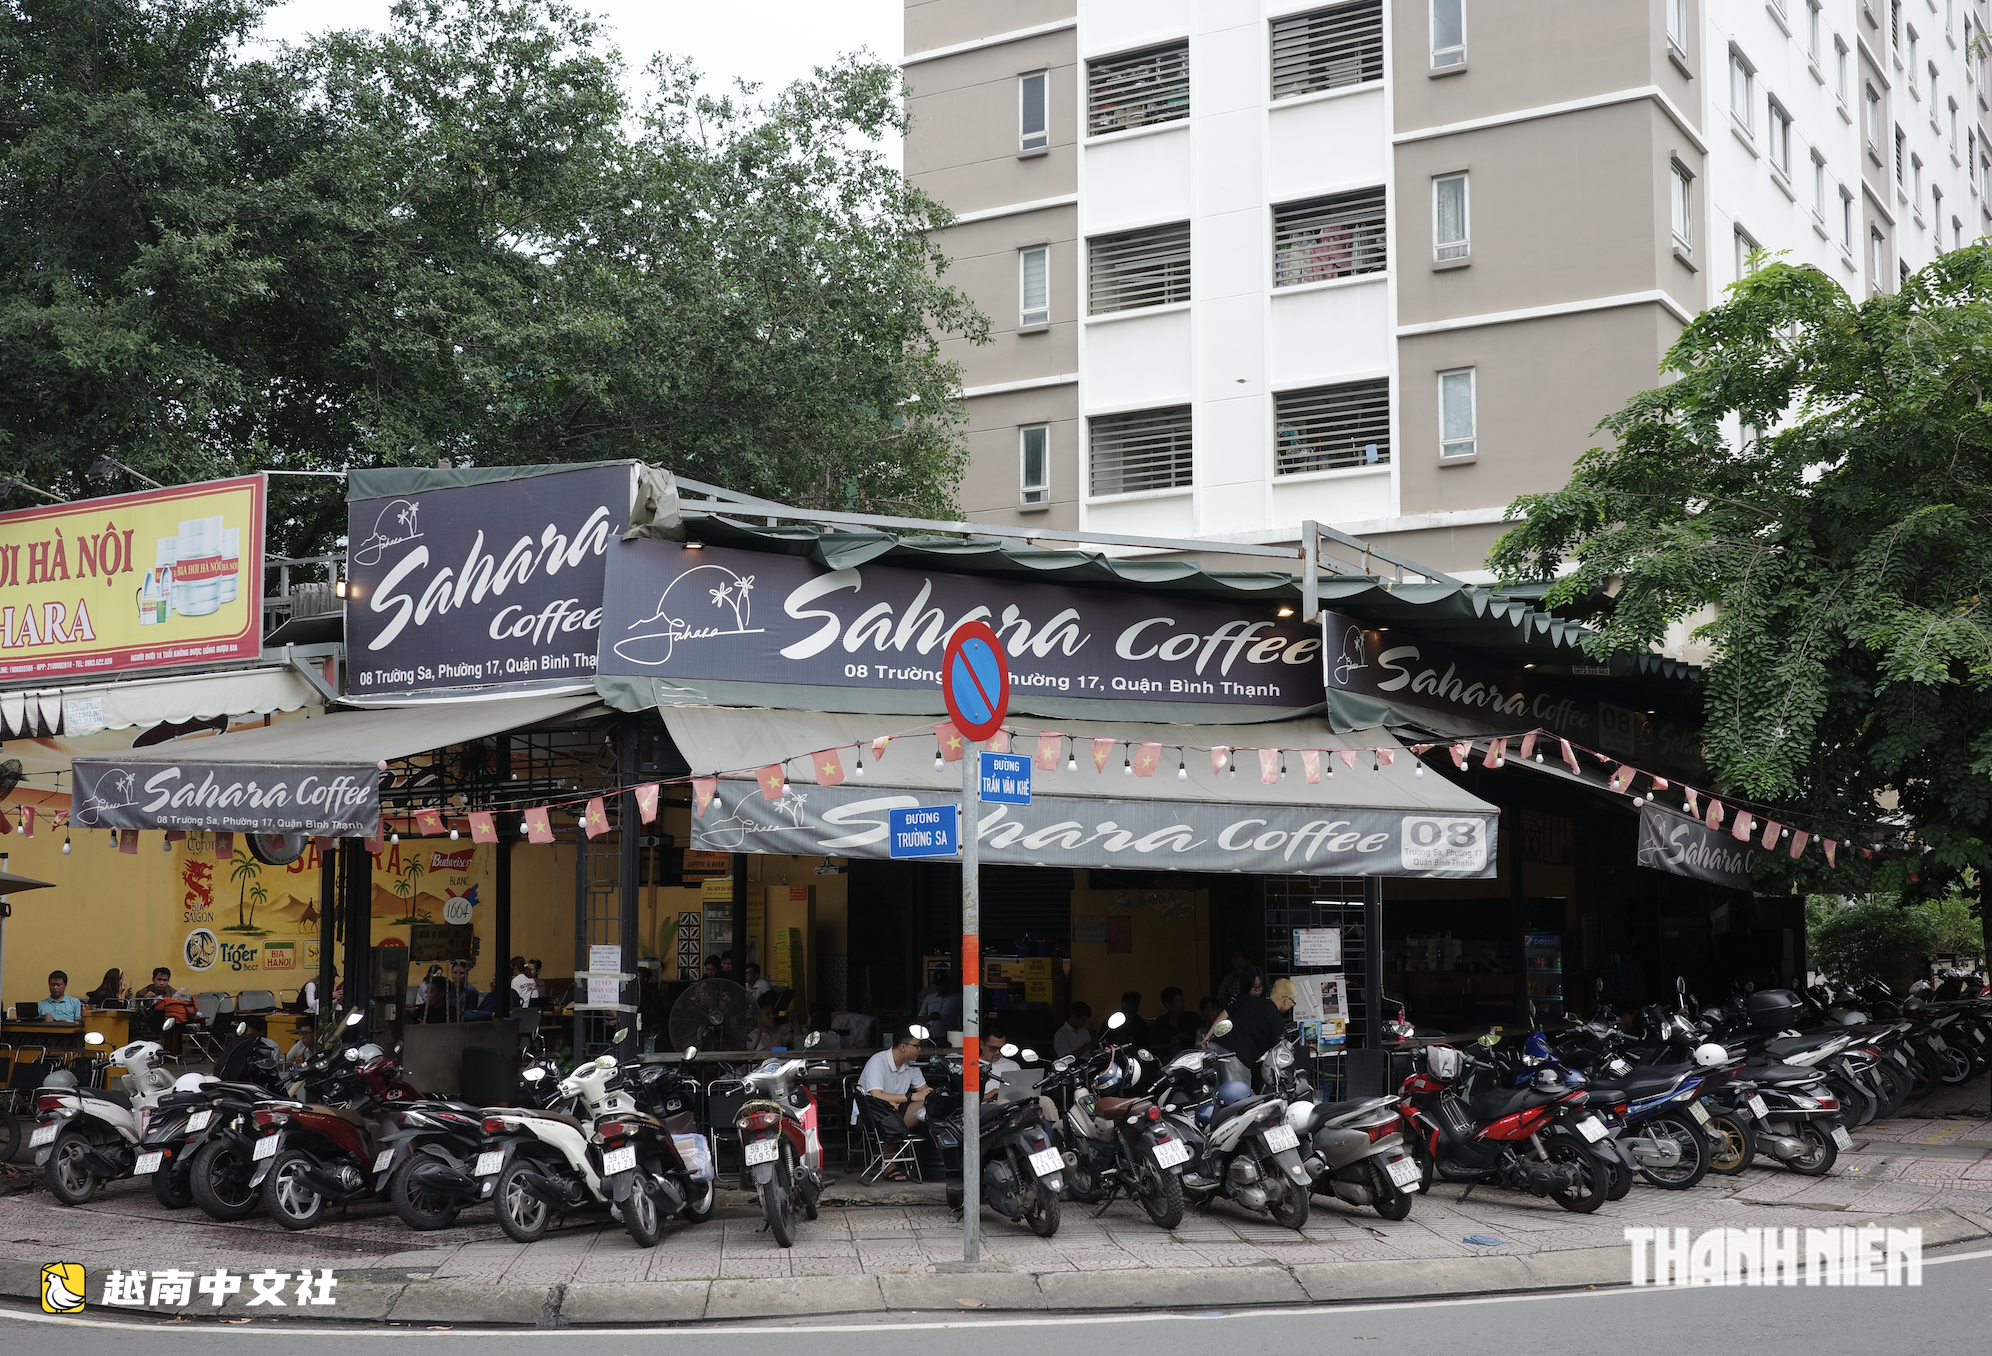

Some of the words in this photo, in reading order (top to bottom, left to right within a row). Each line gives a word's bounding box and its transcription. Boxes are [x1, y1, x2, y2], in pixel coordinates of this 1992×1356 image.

[27, 527, 70, 585] HÀ
[77, 521, 134, 587] NỘI
[368, 506, 619, 651] Sahara
[489, 598, 602, 646] Coffee
[1115, 617, 1322, 677] Coffee
[359, 672, 372, 686] 08
[375, 668, 414, 686] Trường
[417, 666, 435, 682] Sa,
[438, 662, 482, 679] Phường
[485, 660, 502, 676] 17,
[506, 657, 537, 675] Quận
[541, 654, 569, 670] Bình
[573, 653, 597, 672] Thạ
[844, 664, 868, 678] 08
[875, 665, 943, 682] Trường
[1008, 672, 1070, 691] hường
[1077, 676, 1104, 691] 17,
[1111, 677, 1162, 694] Quận
[1170, 679, 1214, 694] Bình
[1220, 681, 1280, 698] Thạnh
[1377, 645, 1530, 717] Sahara
[1532, 693, 1590, 732] Coffee
[1602, 707, 1631, 734] 08
[993, 757, 1020, 772] ĐƯỜNG
[142, 767, 294, 813] Sahara
[296, 775, 371, 814] Coffee
[982, 772, 1000, 793] TRẦN
[1002, 776, 1015, 795] VĂN
[1017, 776, 1030, 796] KHÊ
[156, 816, 168, 824] 08
[170, 816, 203, 826] Trường
[206, 817, 220, 826] Sa,
[223, 818, 259, 828] Phường
[262, 819, 276, 828] 17,
[277, 819, 301, 828] Quận
[306, 819, 329, 829] Bình
[331, 820, 364, 831] Thạnh
[905, 810, 940, 825] ĐƯỜNG
[817, 795, 1207, 853] Shara
[1217, 818, 1390, 862] Coffee
[1410, 821, 1477, 848] 08
[897, 828, 932, 848] TRƯỜNG
[935, 830, 948, 846] SA
[1405, 848, 1431, 857] Trường
[1445, 849, 1472, 858] Phường
[1667, 823, 1745, 874] Sahara
[430, 852, 473, 869] Budweiser
[449, 876, 470, 886] BLANC
[191, 903, 204, 911] BIA
[447, 901, 469, 918] 1664
[184, 912, 215, 923] SAIGON
[419, 930, 430, 939] BIA
[1533, 937, 1556, 947] pepsi
[220, 943, 258, 971] Tiger
[267, 958, 292, 967] HANOI
[271, 950, 285, 958] BIA
[748, 1149, 776, 1164] 549.56
[606, 1158, 634, 1174] 941.23
